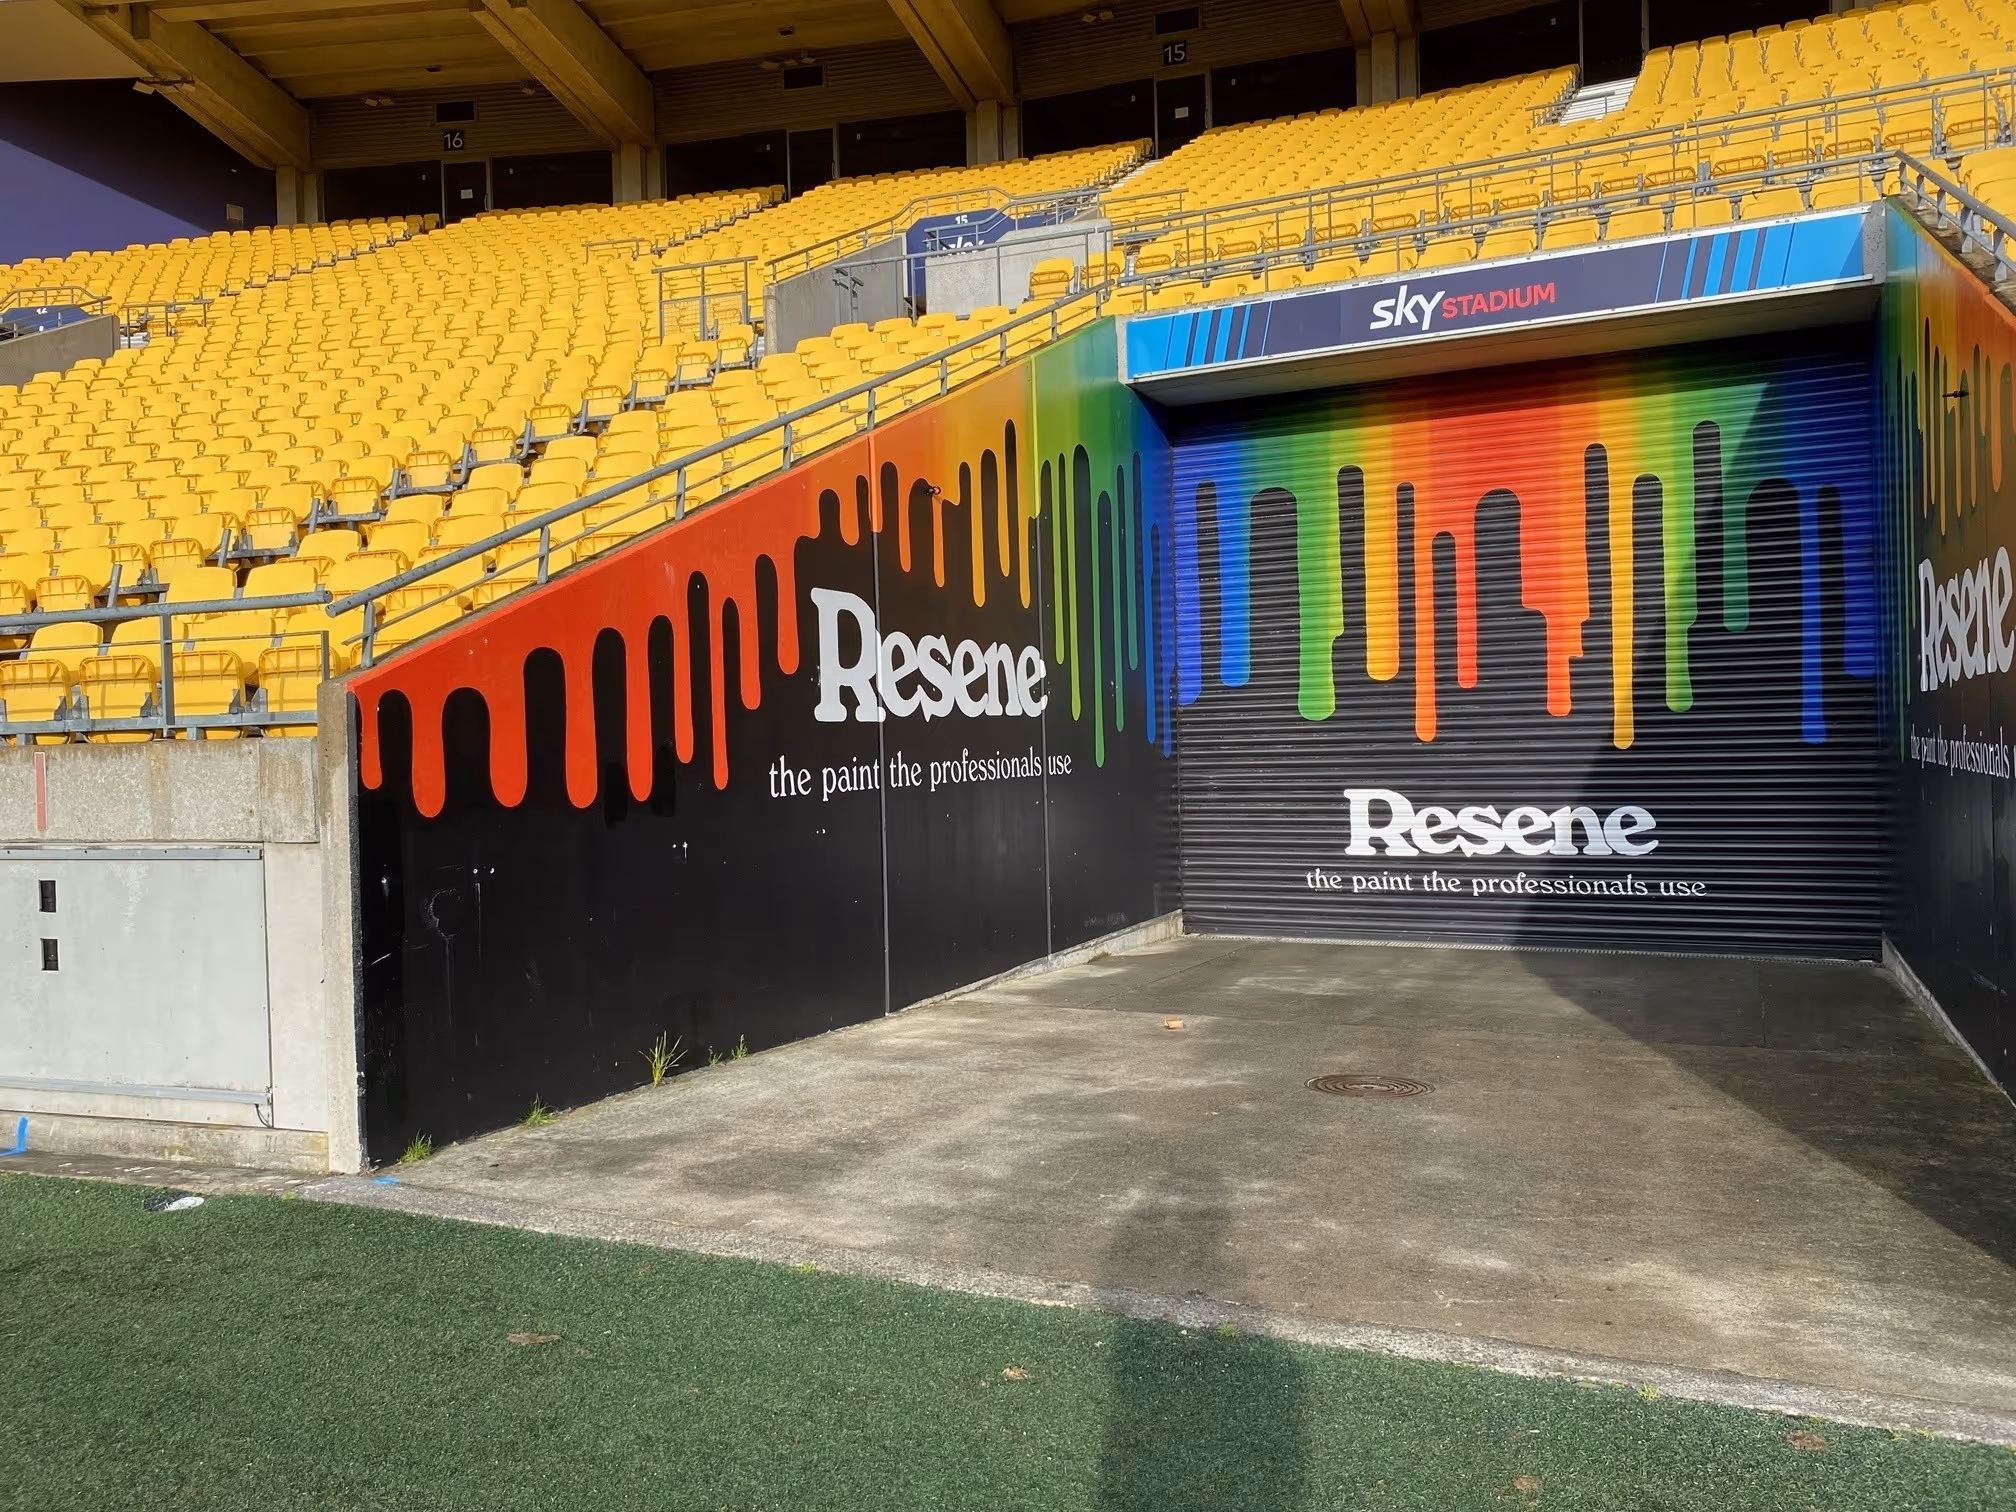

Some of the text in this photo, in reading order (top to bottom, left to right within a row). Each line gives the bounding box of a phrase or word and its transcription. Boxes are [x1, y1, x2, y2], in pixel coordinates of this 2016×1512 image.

[1164, 43, 1186, 63] 15
[443, 132, 463, 149] 16
[955, 214, 969, 225] 15
[1369, 282, 1556, 331] sky STADIUM
[1917, 546, 2016, 692] Resene
[810, 587, 1049, 723] Resene
[769, 746, 1073, 802] the paint the professionals use
[1910, 723, 1920, 761] the
[1937, 724, 1949, 767] the
[1950, 723, 2010, 780] professionals
[1343, 788, 1660, 859] Resene
[1306, 867, 1708, 898] the paint the professionals use
